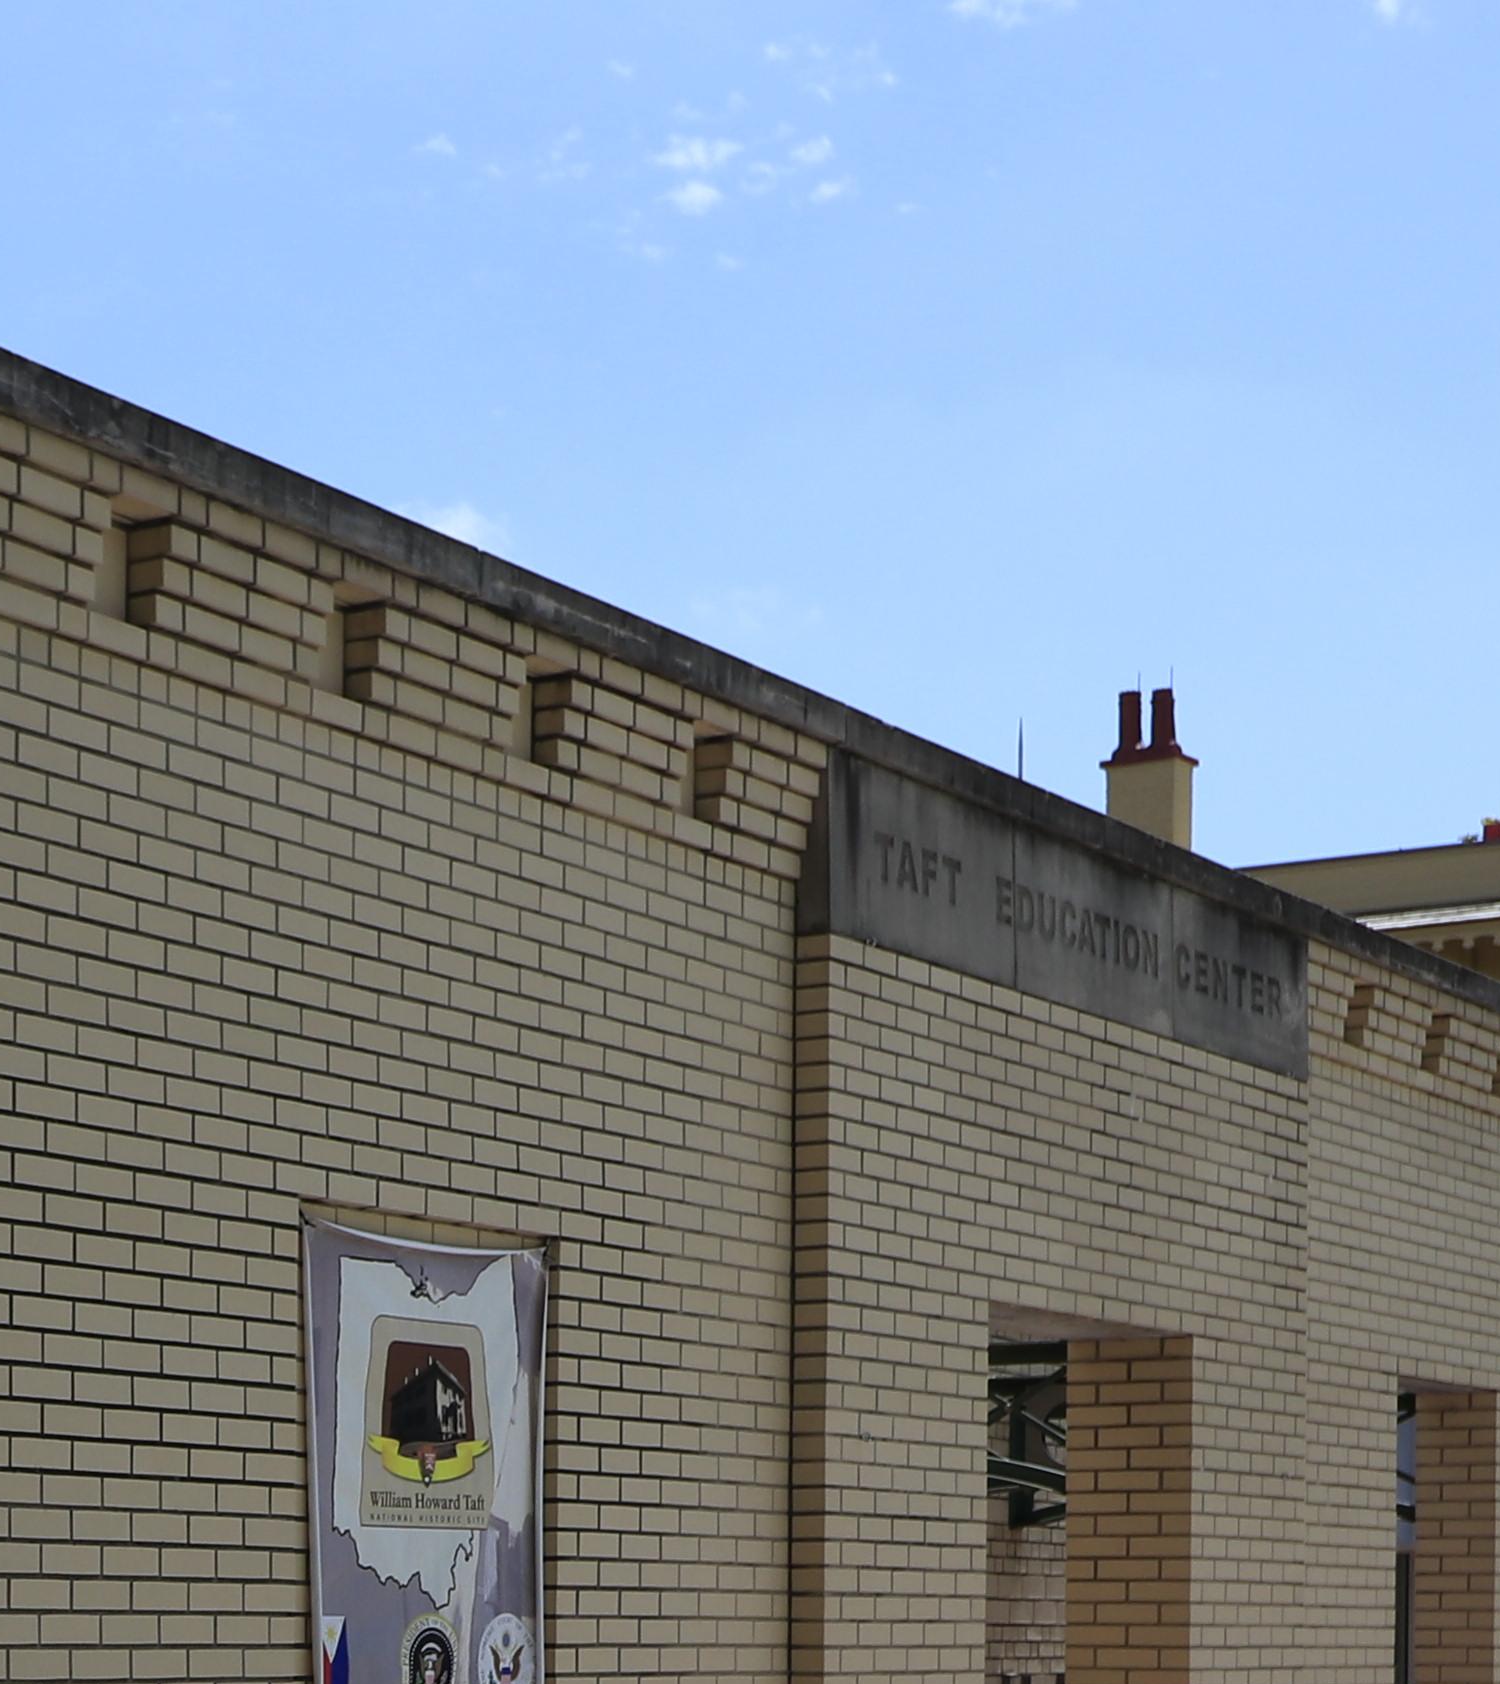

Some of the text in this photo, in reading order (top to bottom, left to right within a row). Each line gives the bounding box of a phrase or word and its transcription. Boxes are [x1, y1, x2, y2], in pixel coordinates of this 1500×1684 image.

[875, 831, 1283, 1018] TAFT EDUCATION CENTER
[370, 1491, 485, 1511] William Howard Taft
